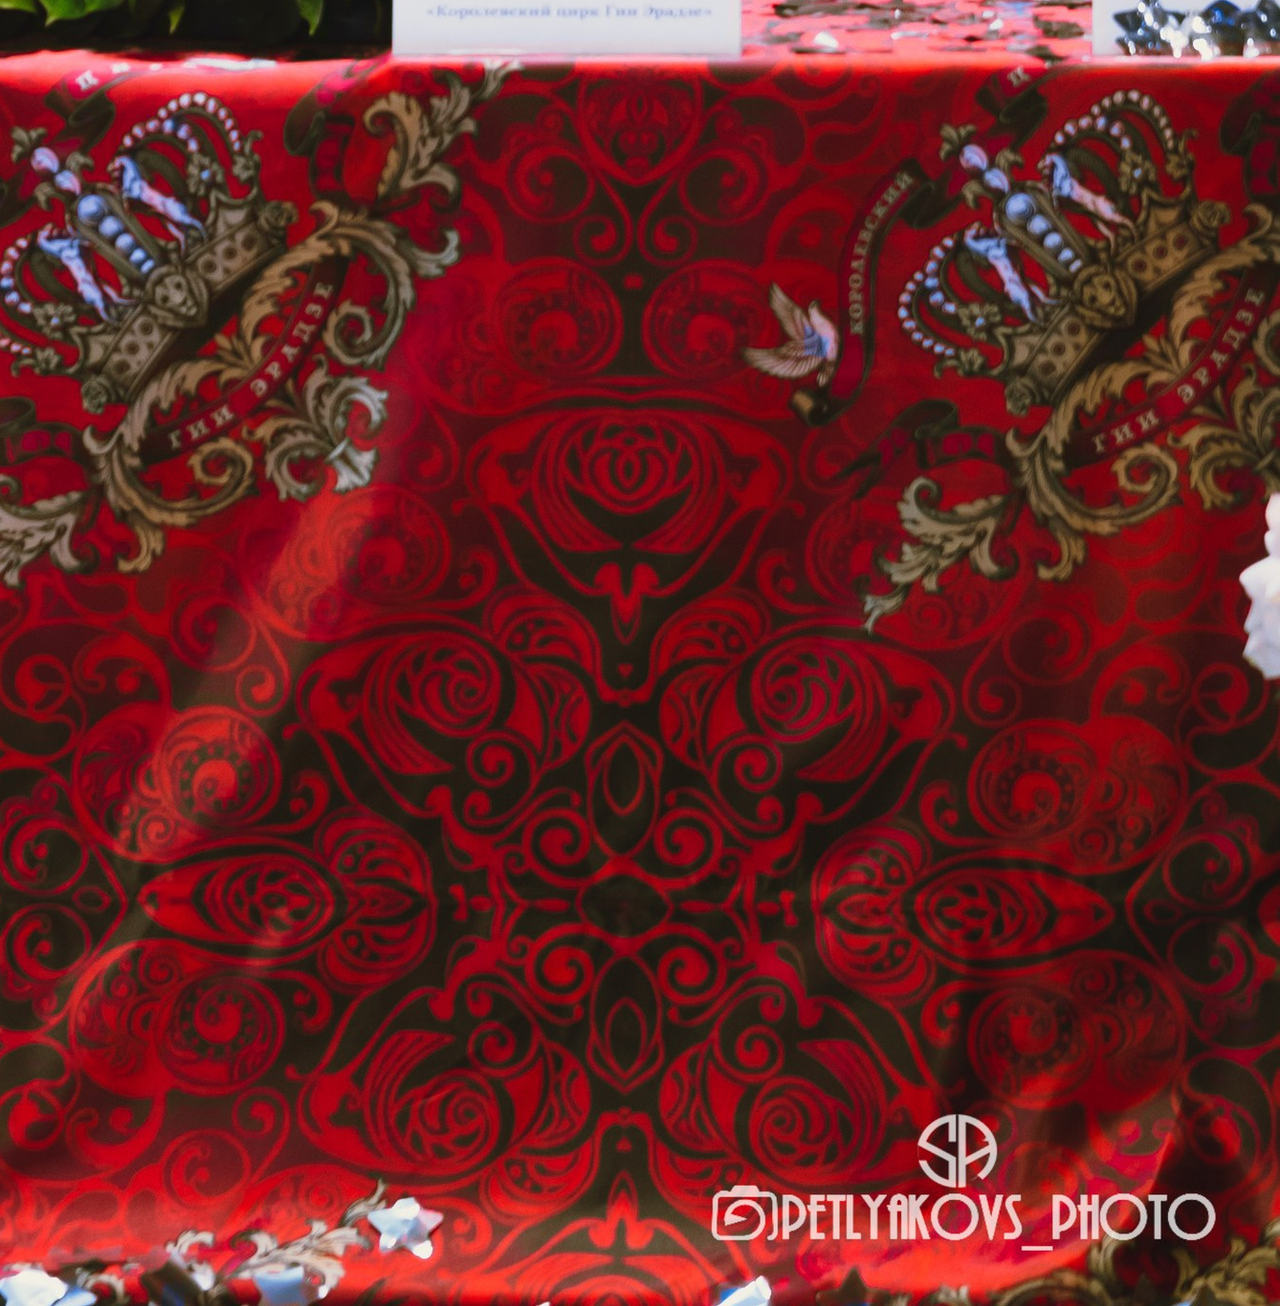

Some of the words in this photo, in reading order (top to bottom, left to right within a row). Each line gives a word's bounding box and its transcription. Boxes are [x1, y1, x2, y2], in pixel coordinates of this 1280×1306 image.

[555, 6, 600, 20] цирк
[605, 5, 637, 17] Гии
[250, 282, 333, 397] ЭРАДЗЕ
[1177, 289, 1265, 403] ЭРАДЗЕ
